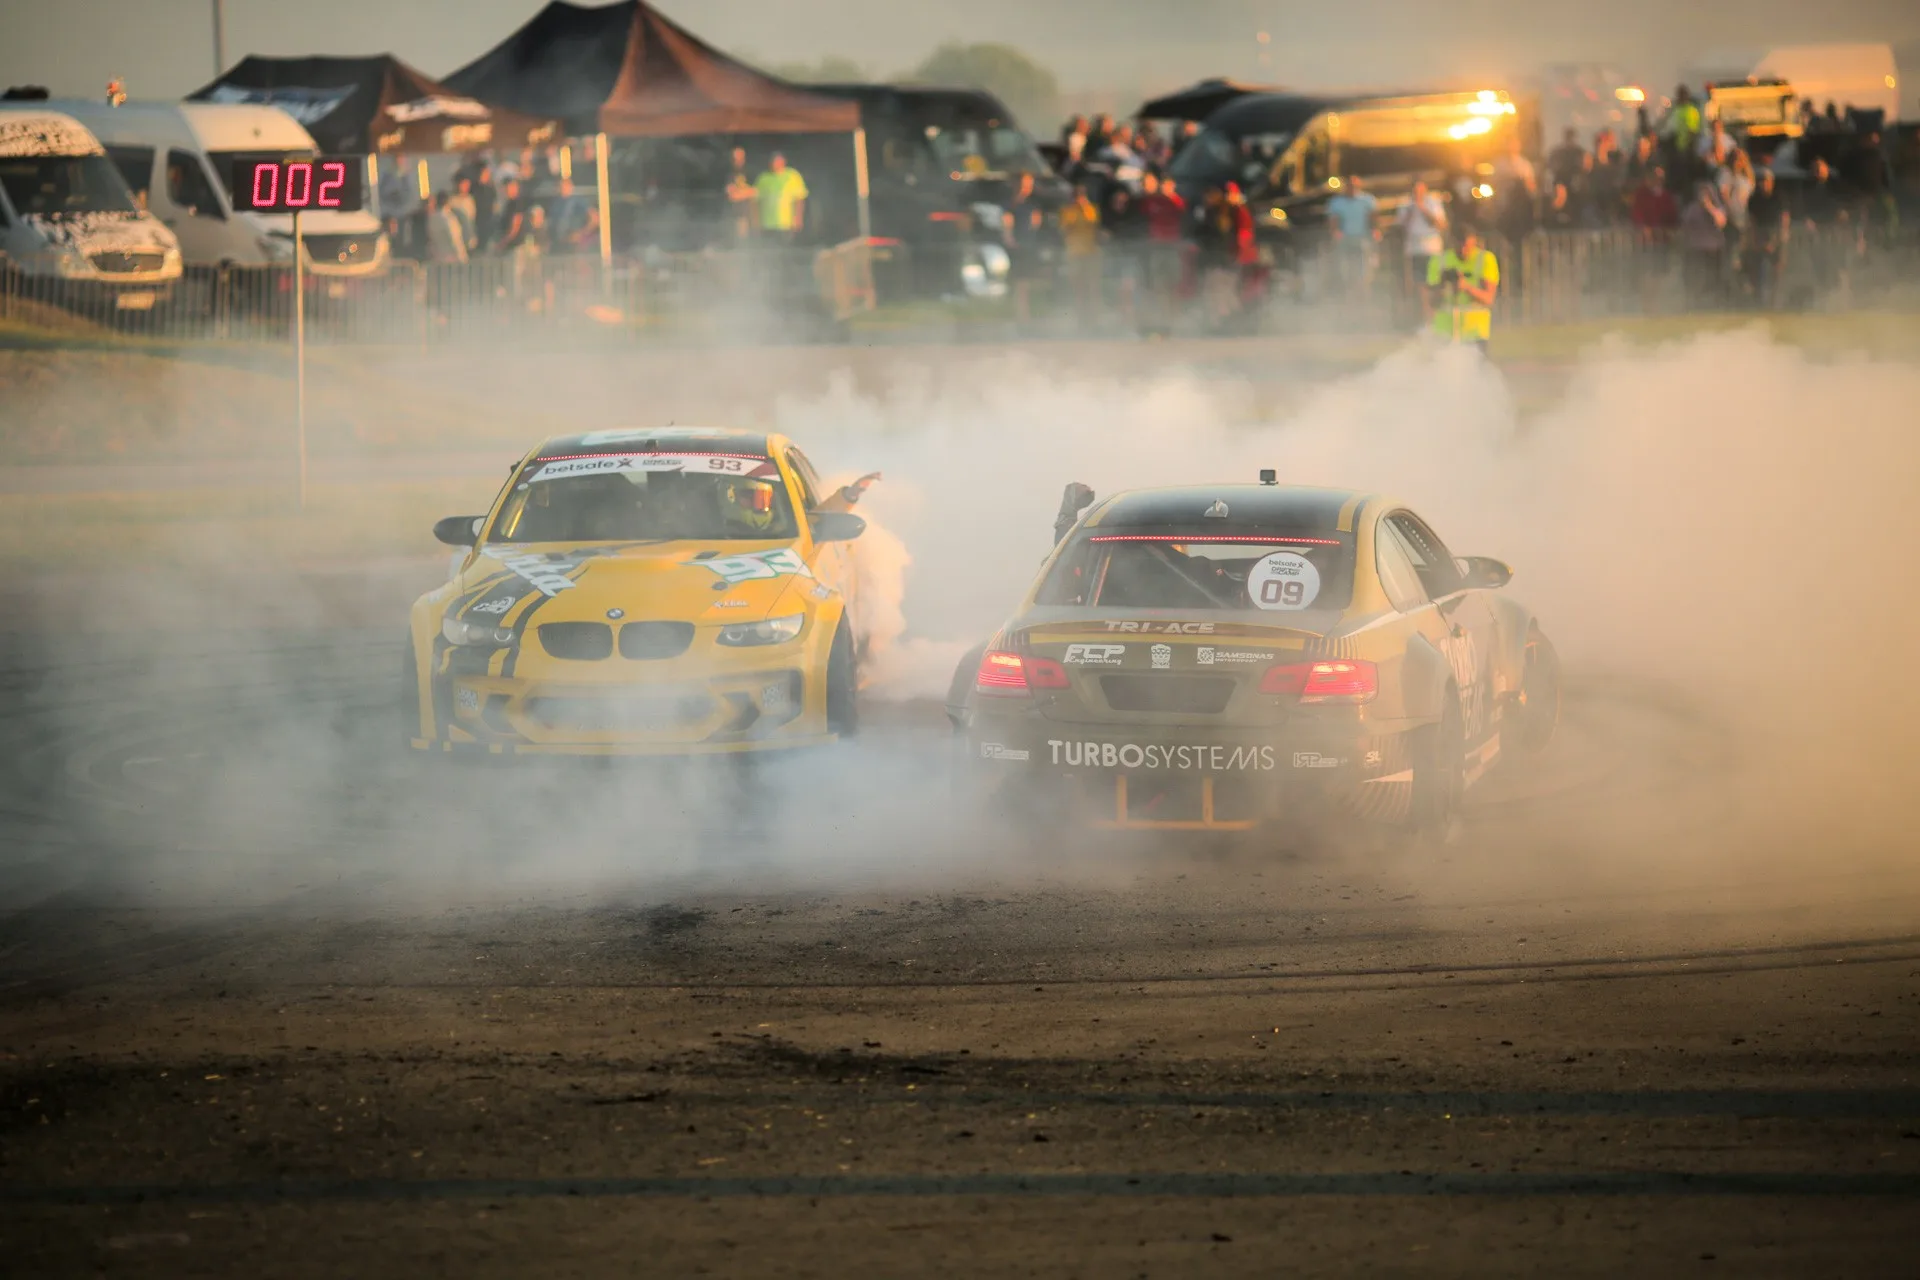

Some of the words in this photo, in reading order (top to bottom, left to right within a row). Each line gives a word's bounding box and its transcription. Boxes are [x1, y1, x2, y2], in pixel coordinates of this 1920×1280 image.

[252, 163, 345, 207] 002
[544, 459, 614, 475] betsafe
[708, 458, 742, 472] 93
[1260, 579, 1304, 606] 09
[1064, 644, 1126, 663] FCP
[1068, 655, 1122, 665] Engineering
[1215, 651, 1275, 661] SAMSONAS
[1048, 740, 1275, 770] TURBOSYSTEMS
